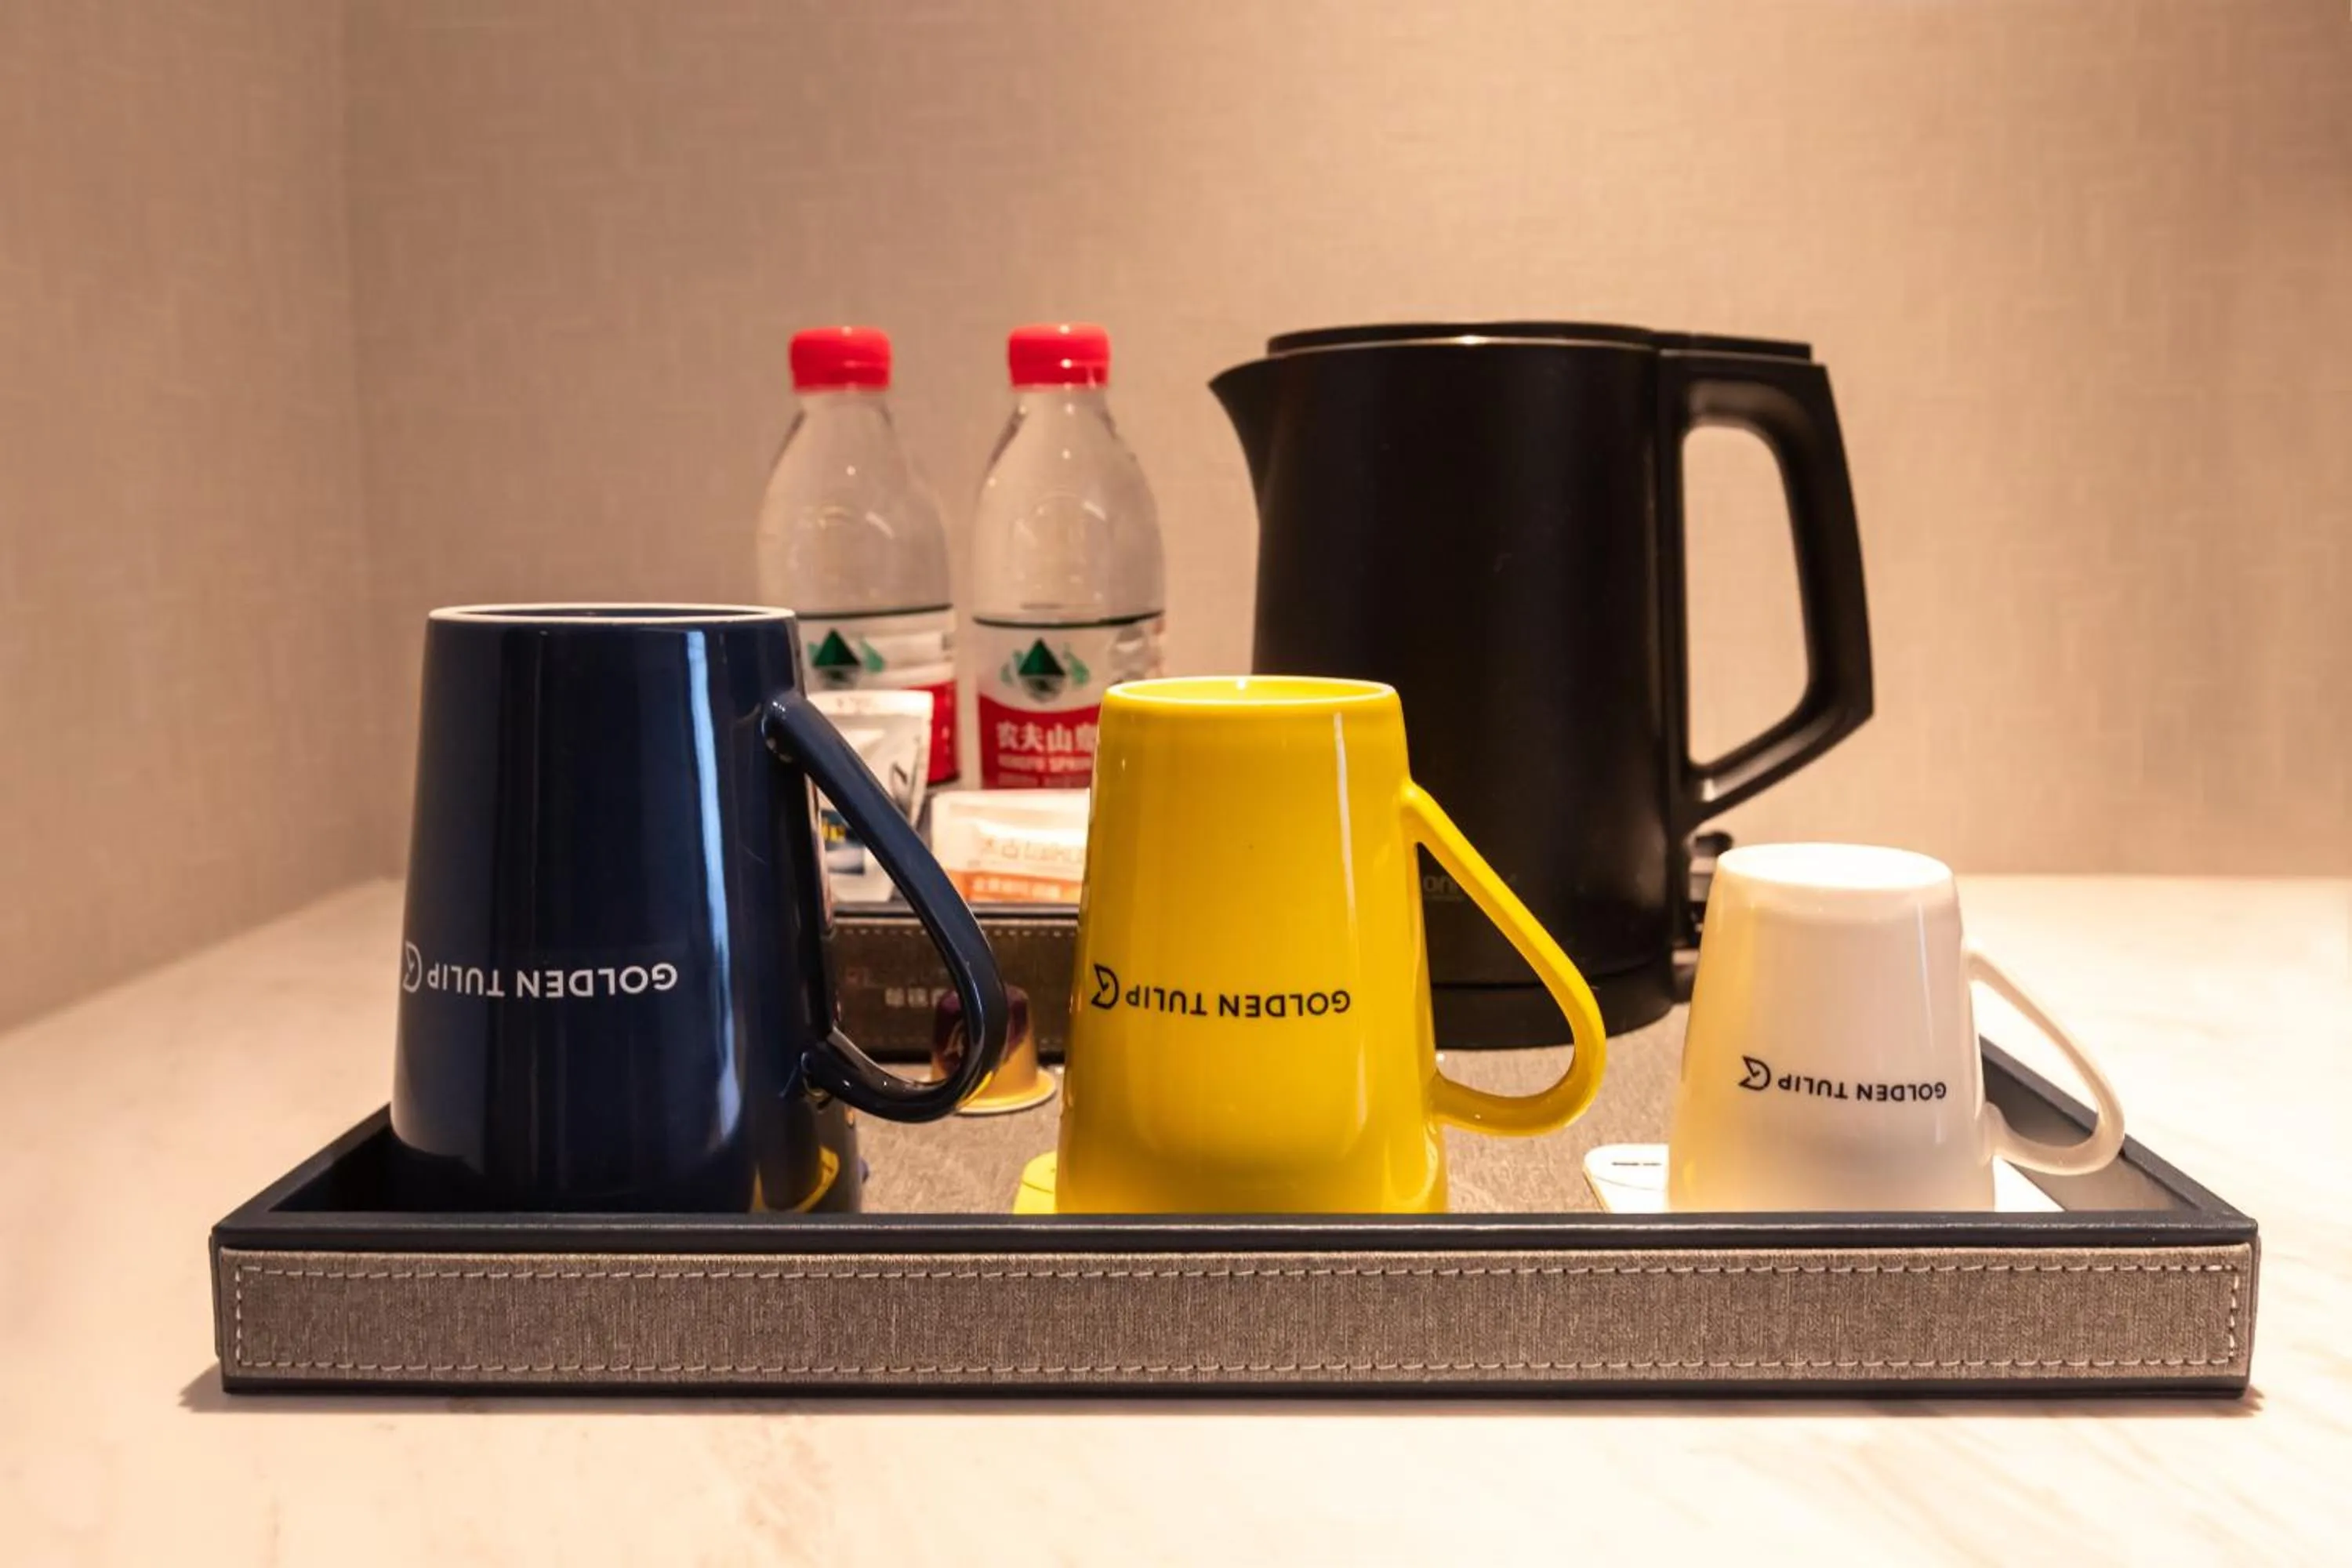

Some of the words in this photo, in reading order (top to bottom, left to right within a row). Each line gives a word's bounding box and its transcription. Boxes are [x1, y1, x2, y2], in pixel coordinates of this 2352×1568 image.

[426, 962, 506, 997] TULIP
[516, 963, 678, 999] GOLDEN
[1125, 984, 1208, 1016] TULIP
[1218, 989, 1351, 1018] GOLDEN
[1777, 1073, 1849, 1099] TULIP
[1856, 1081, 1947, 1102] GOLDEN
